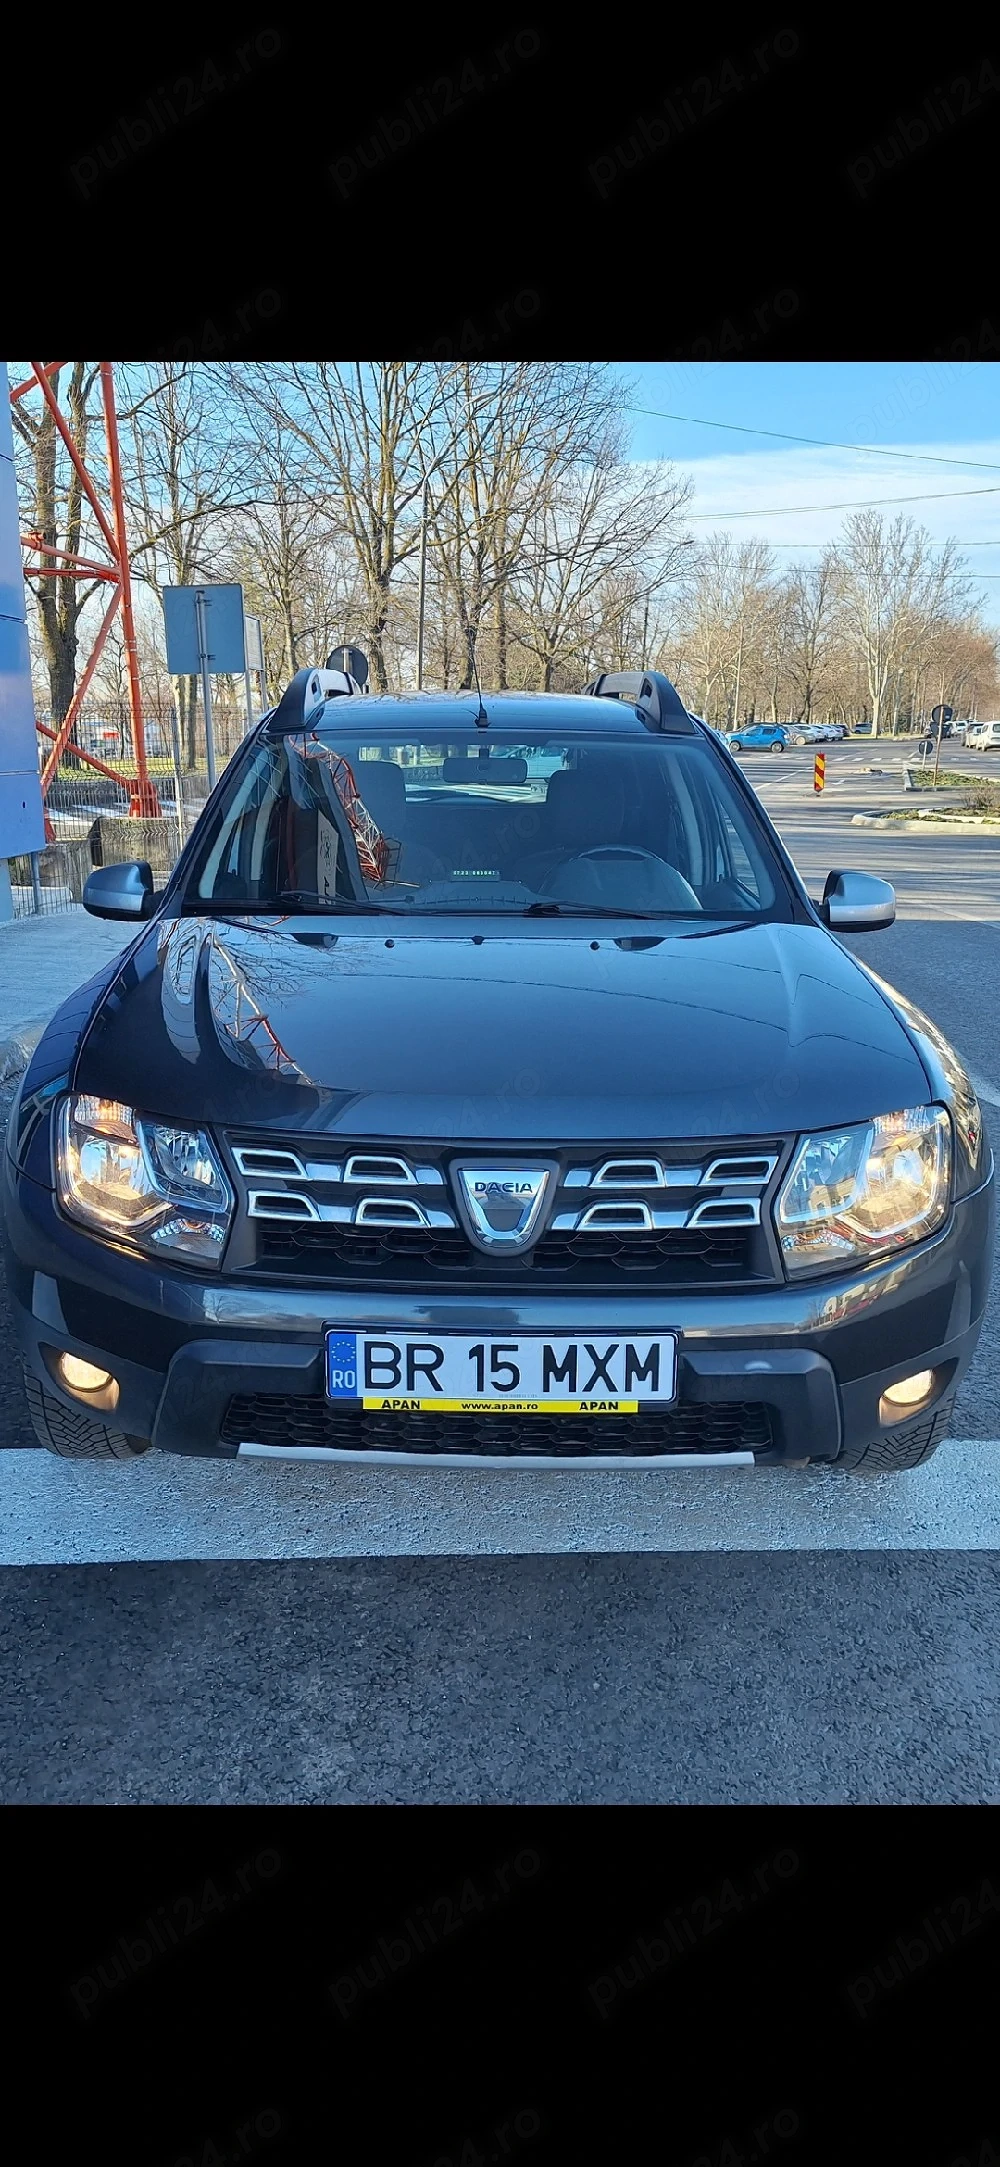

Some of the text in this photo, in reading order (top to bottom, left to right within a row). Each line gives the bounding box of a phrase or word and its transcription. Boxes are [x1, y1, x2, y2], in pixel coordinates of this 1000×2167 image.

[474, 1182, 533, 1194] DACIA
[364, 1340, 660, 1394] BR 15 MXM
[332, 1370, 356, 1389] RO
[381, 1399, 619, 1411] APAN www.apan.ro APAN
